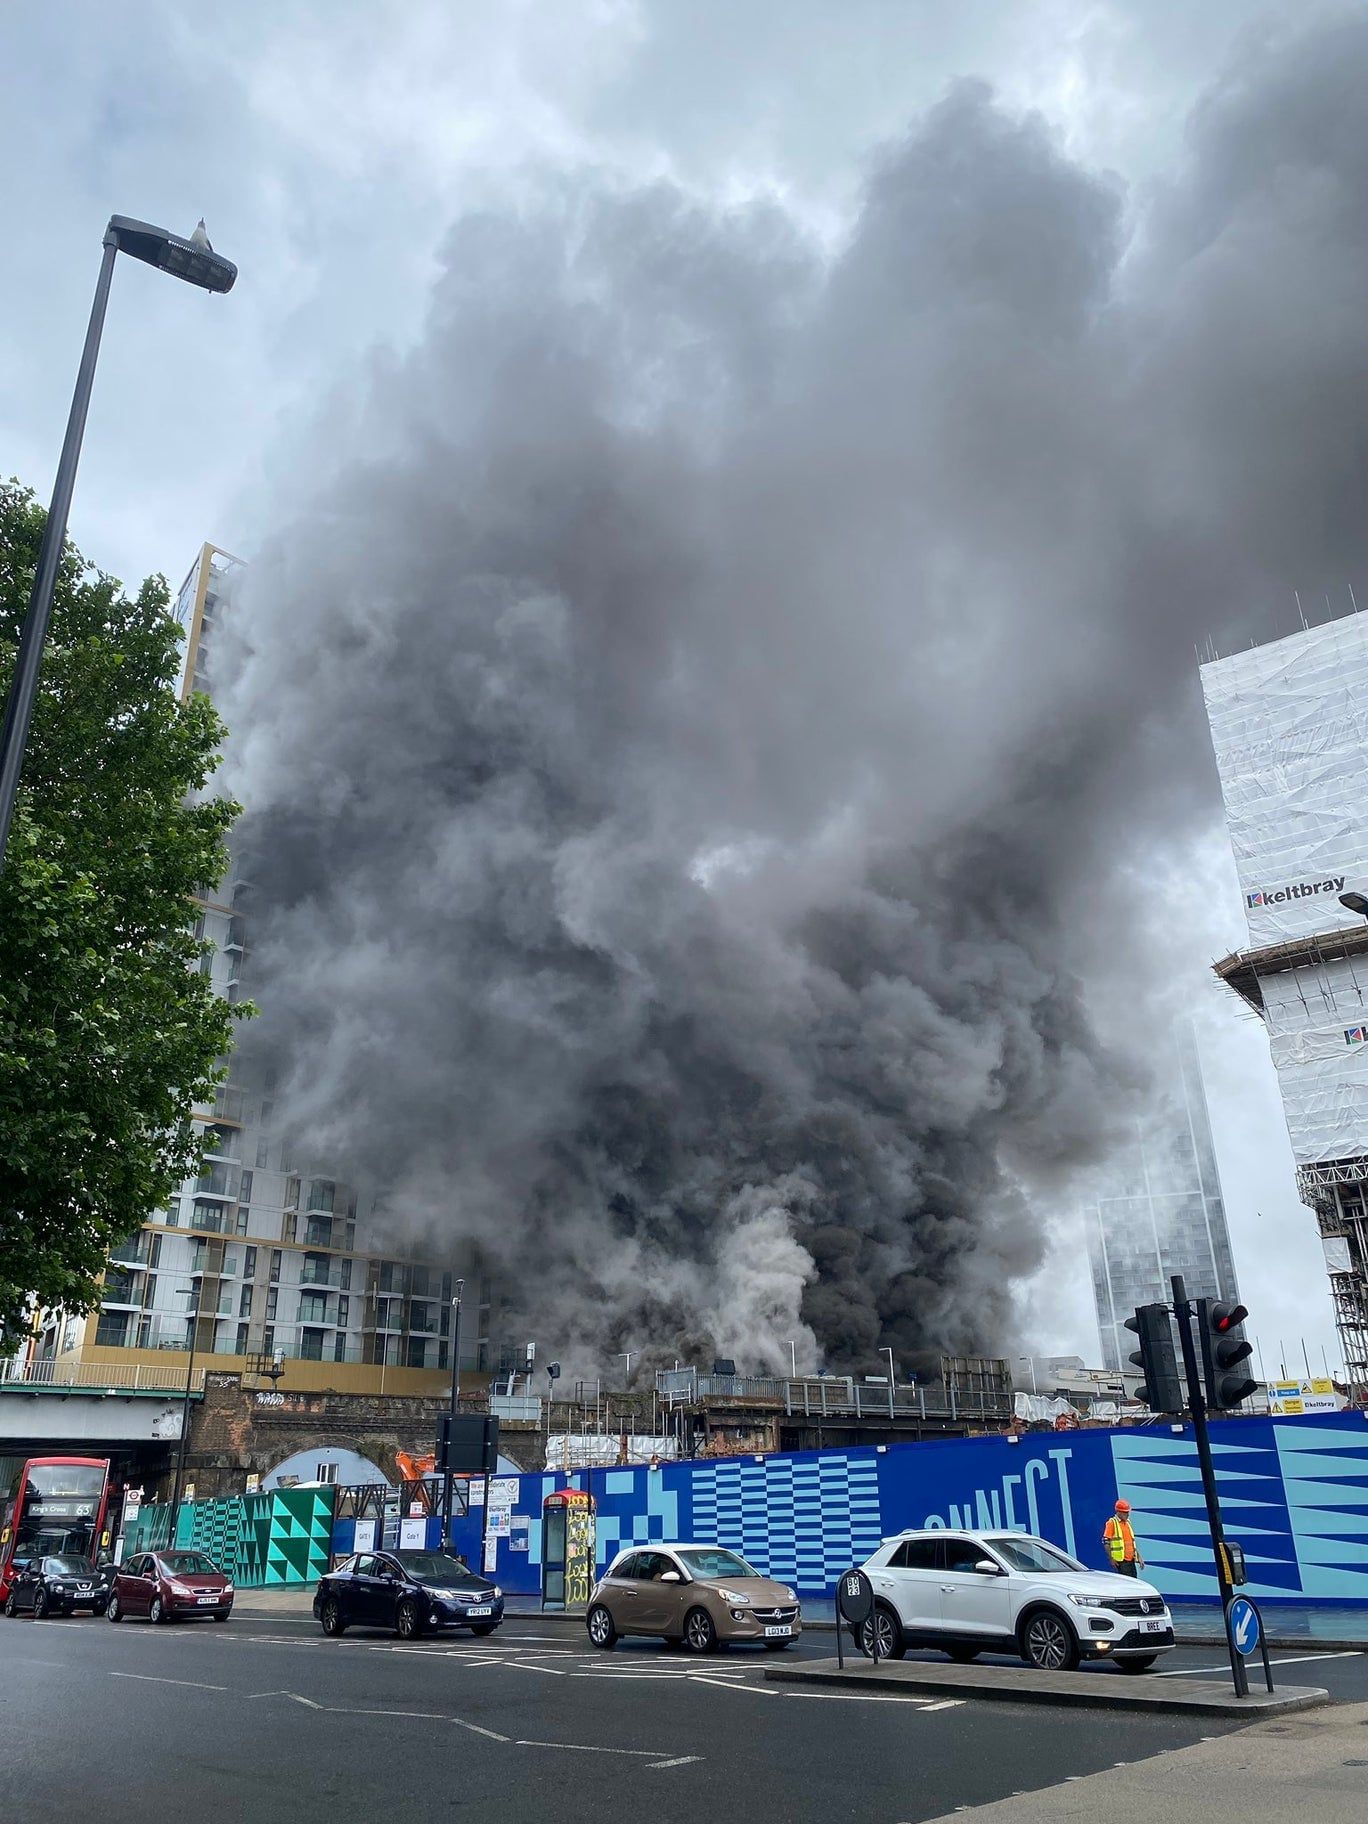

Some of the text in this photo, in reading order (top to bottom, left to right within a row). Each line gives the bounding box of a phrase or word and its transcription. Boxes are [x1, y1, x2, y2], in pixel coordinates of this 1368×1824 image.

[1262, 877, 1345, 906] keltbray
[76, 1505, 90, 1515] 63
[848, 1586, 859, 1595] 23
[1146, 1622, 1160, 1631] BREE
